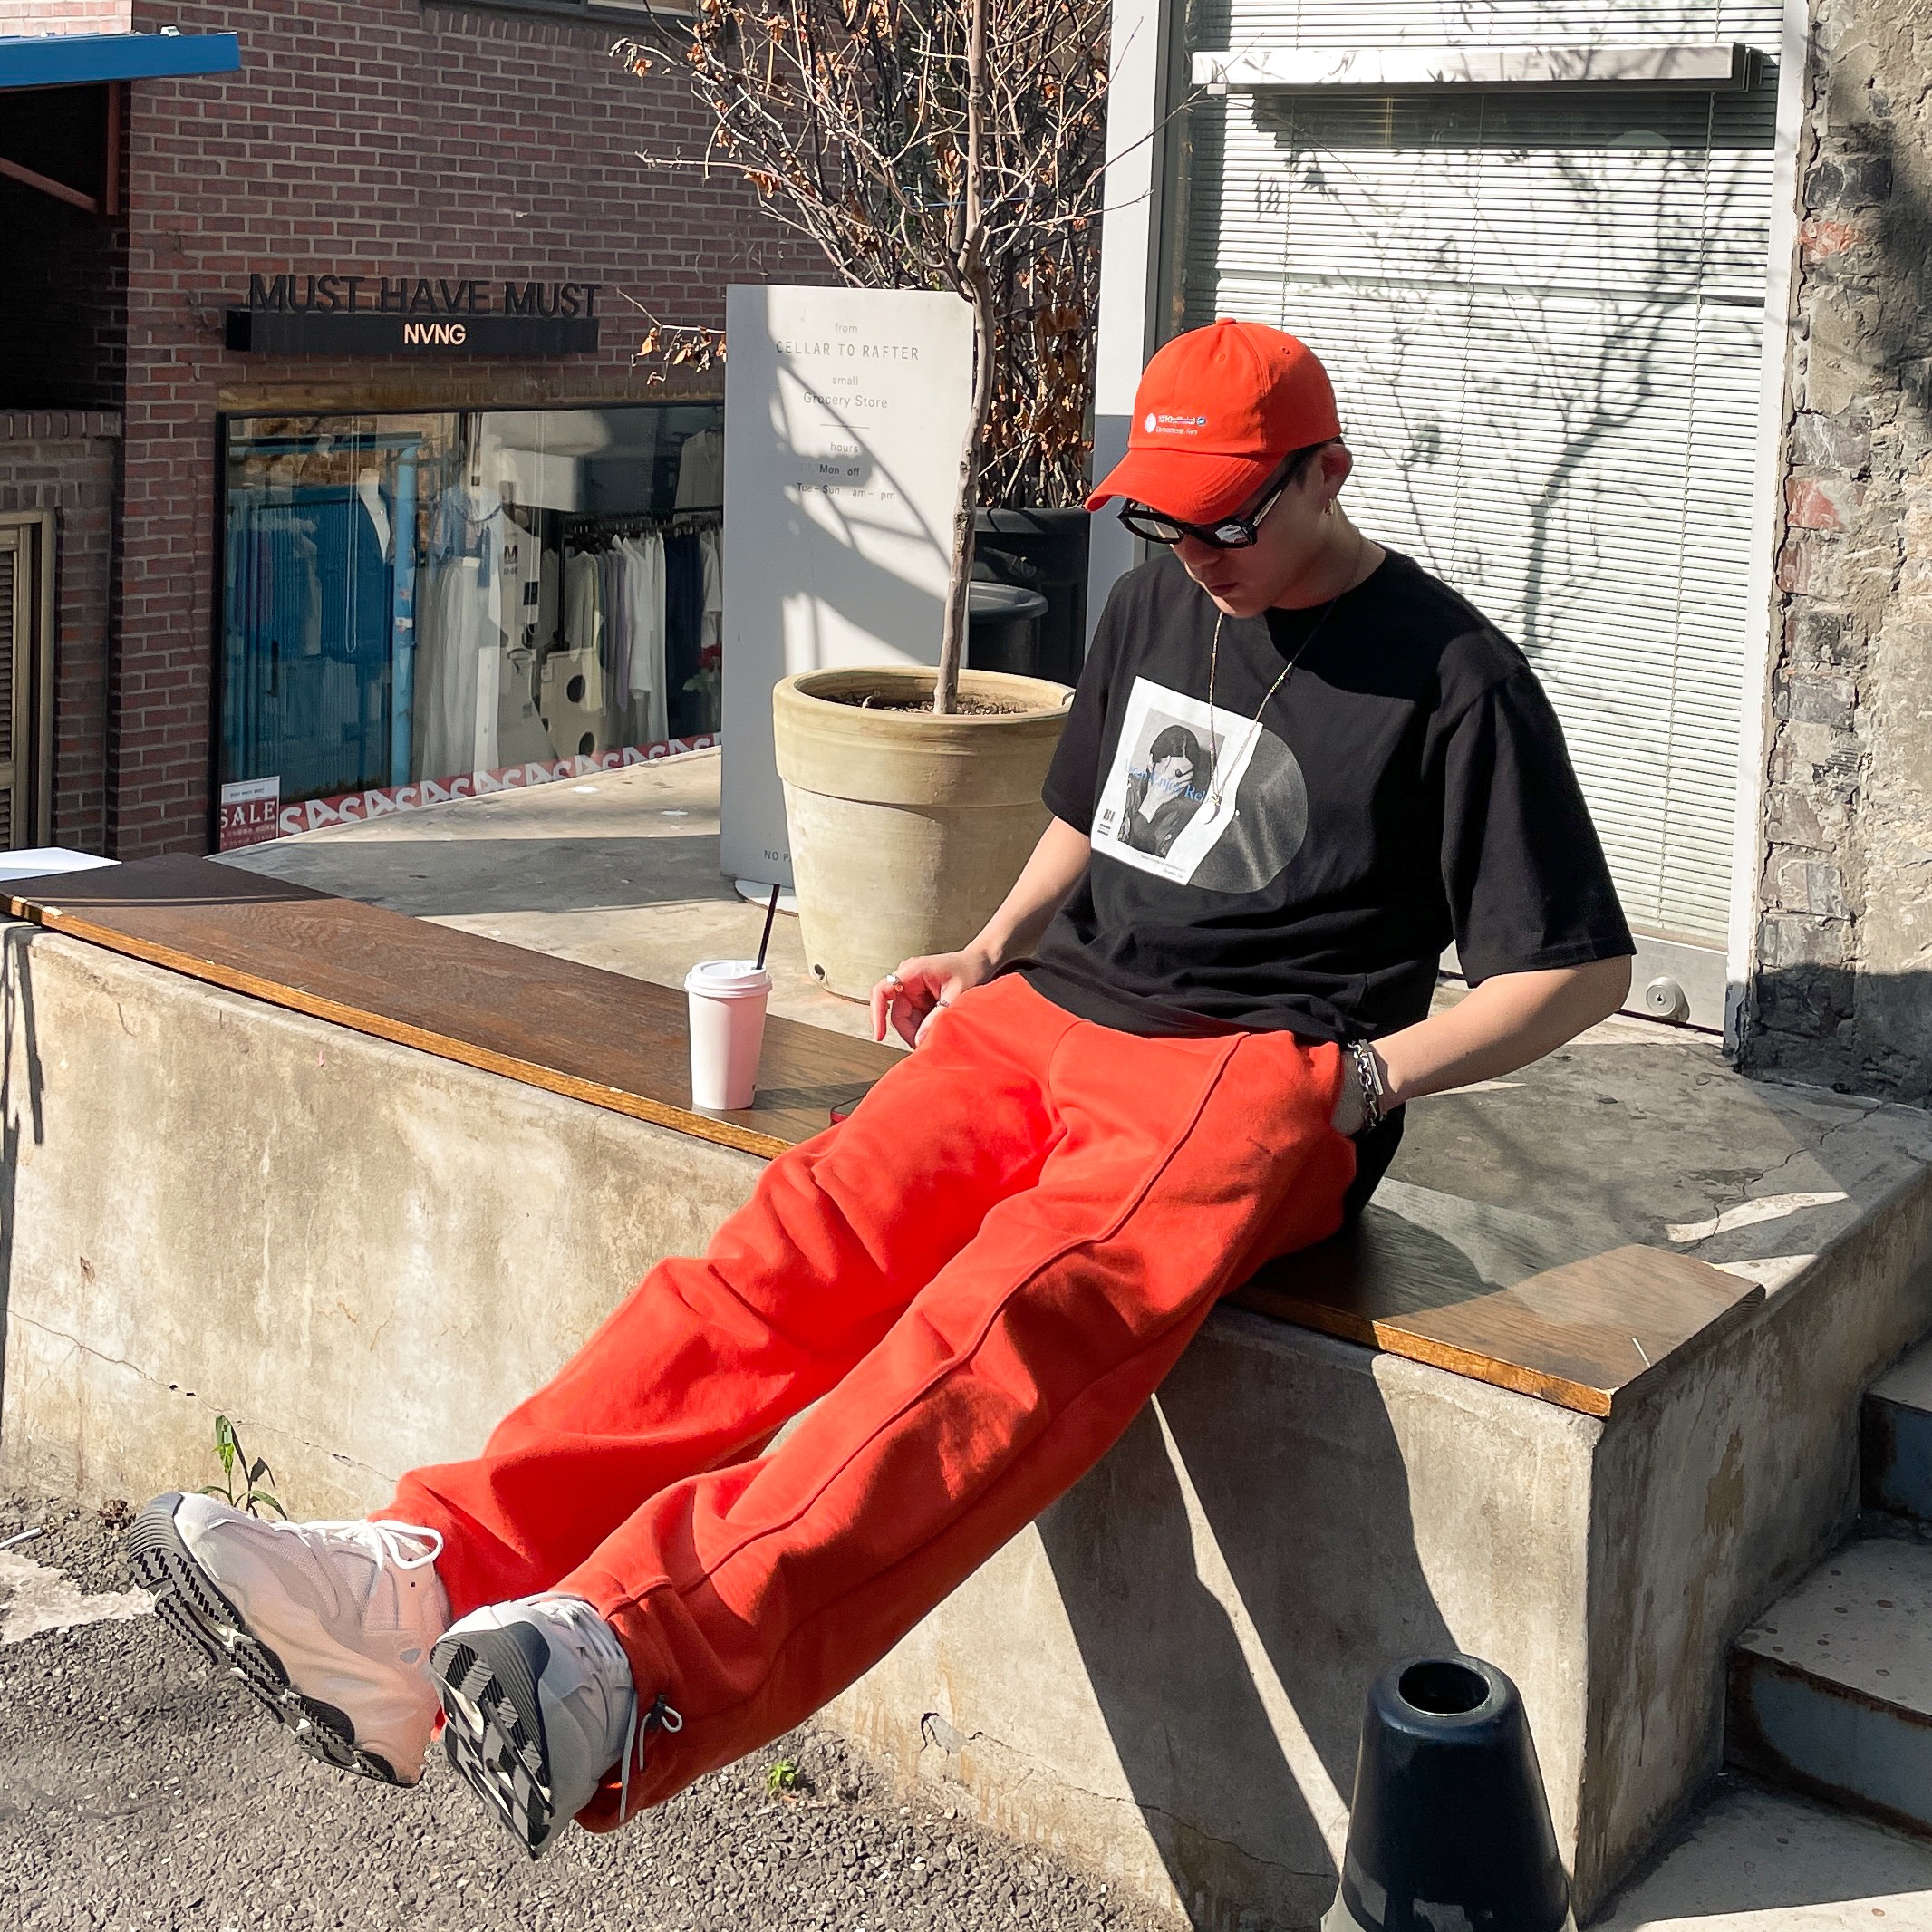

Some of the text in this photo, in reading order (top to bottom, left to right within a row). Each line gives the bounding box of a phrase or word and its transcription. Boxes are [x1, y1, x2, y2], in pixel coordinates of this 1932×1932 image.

[249, 273, 602, 318] MUST HAVE MUST
[403, 323, 467, 345] NVNG
[834, 323, 858, 333] from
[776, 340, 919, 361] CELLAR TO RAFTER
[832, 376, 859, 386] small
[803, 391, 888, 409] Grocery Store
[830, 442, 859, 454] hours
[819, 463, 860, 477] Mon off
[880, 491, 895, 501] pm
[220, 800, 275, 829] SALE
[763, 849, 779, 861] NO
